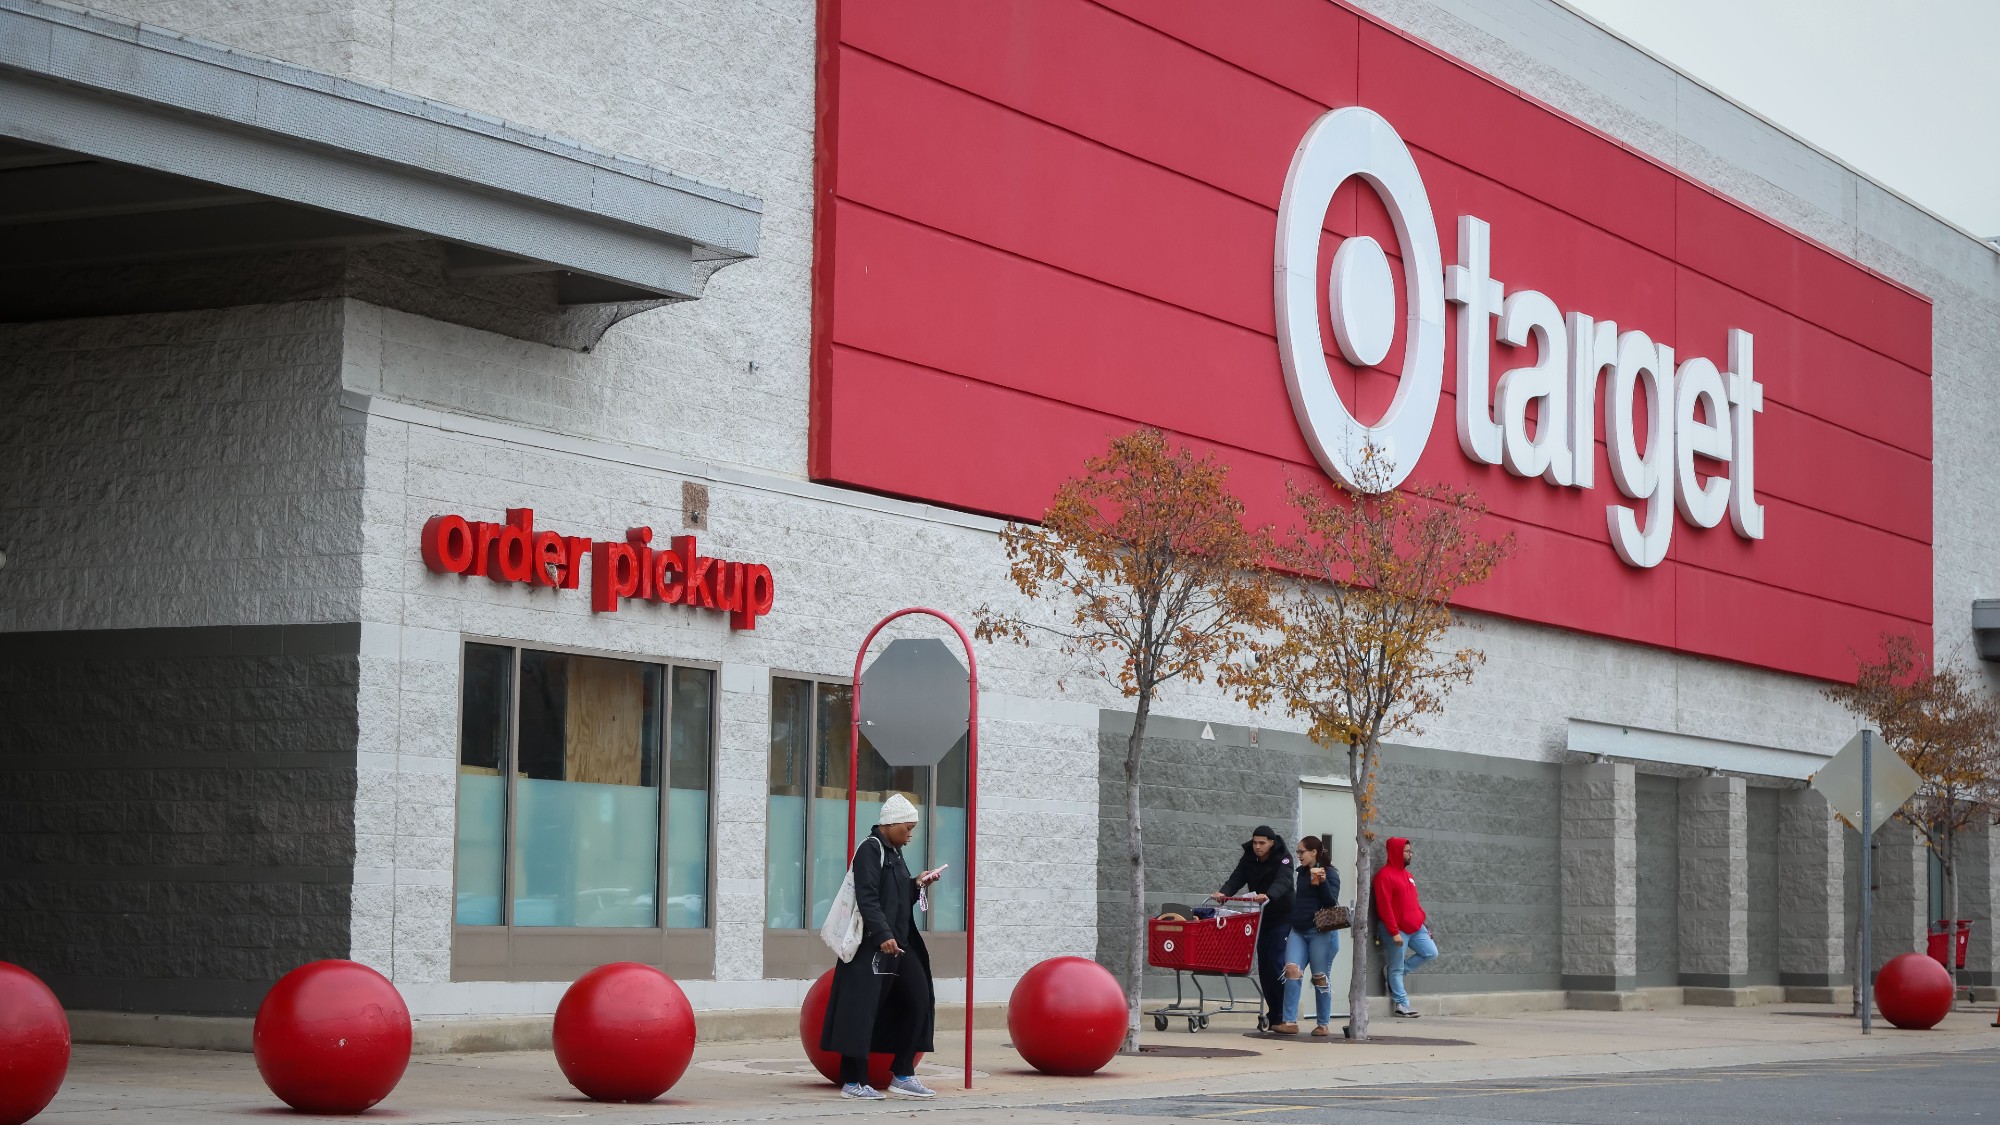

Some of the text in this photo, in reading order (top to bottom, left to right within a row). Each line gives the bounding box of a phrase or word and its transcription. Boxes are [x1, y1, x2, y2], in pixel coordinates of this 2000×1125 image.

[1445, 215, 1764, 568] target
[421, 508, 774, 630] order pickup
